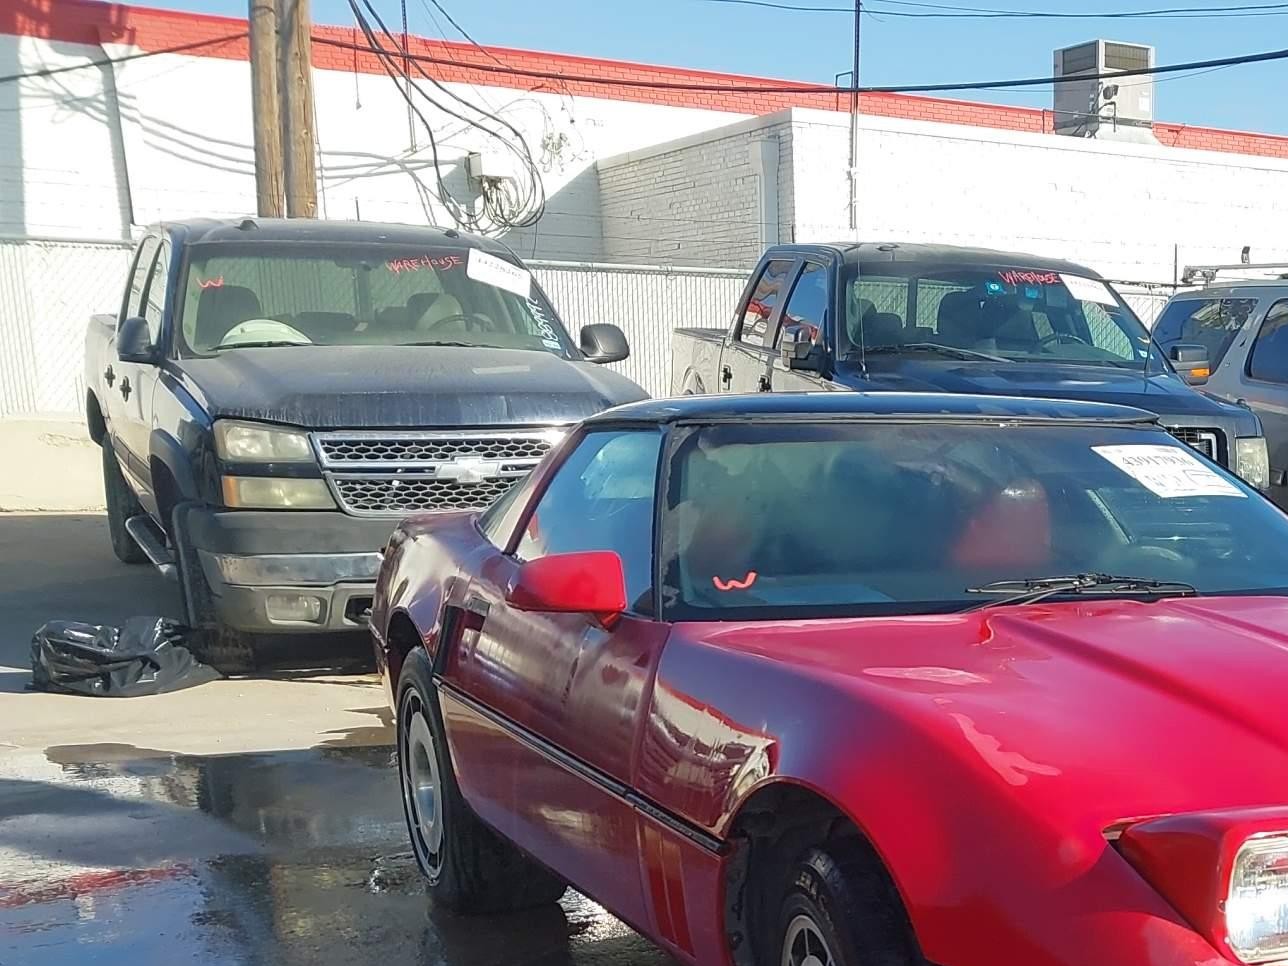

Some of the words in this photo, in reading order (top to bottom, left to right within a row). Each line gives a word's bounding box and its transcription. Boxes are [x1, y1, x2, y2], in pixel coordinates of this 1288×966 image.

[386, 254, 464, 276] WAREHOUSE
[1122, 456, 1194, 466] 43917936
[713, 571, 758, 591] W
